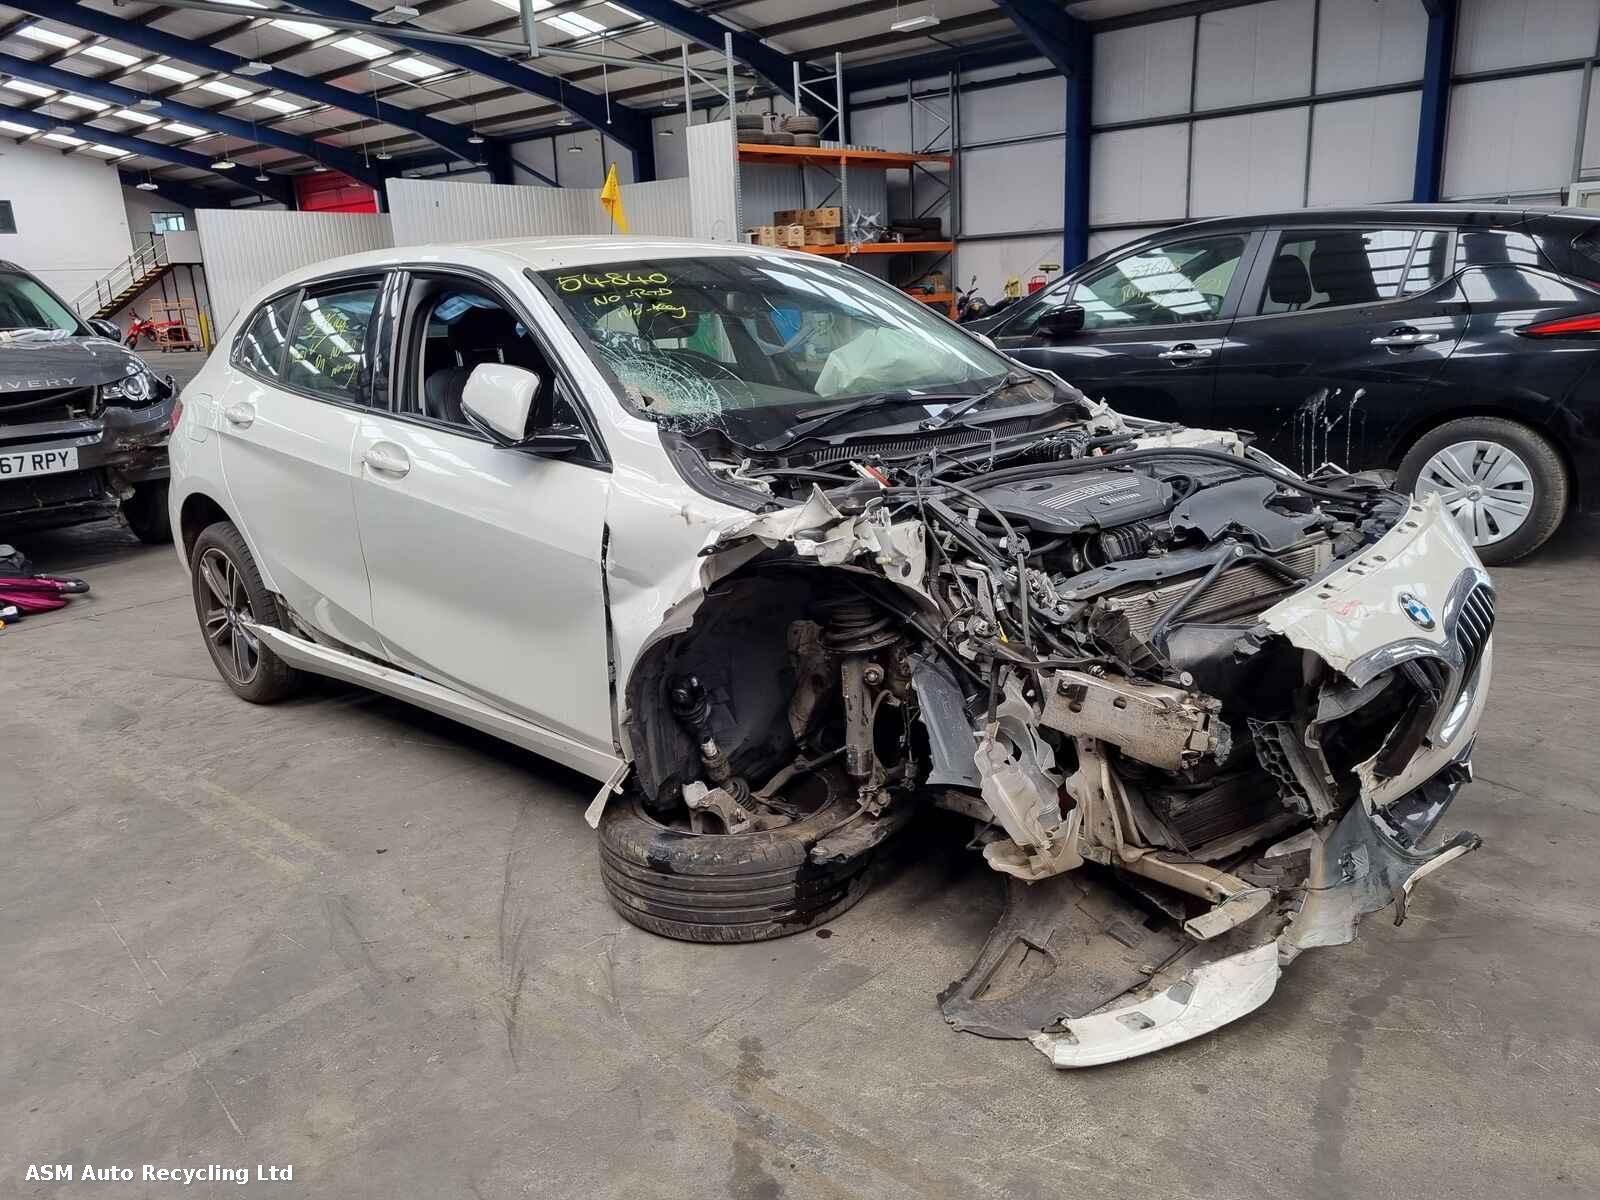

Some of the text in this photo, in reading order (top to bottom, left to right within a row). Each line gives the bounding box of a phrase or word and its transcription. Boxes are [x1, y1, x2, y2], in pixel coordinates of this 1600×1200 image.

[557, 272, 667, 291] 54840
[0, 376, 77, 390] VERY
[0, 450, 69, 474] 67 RPY
